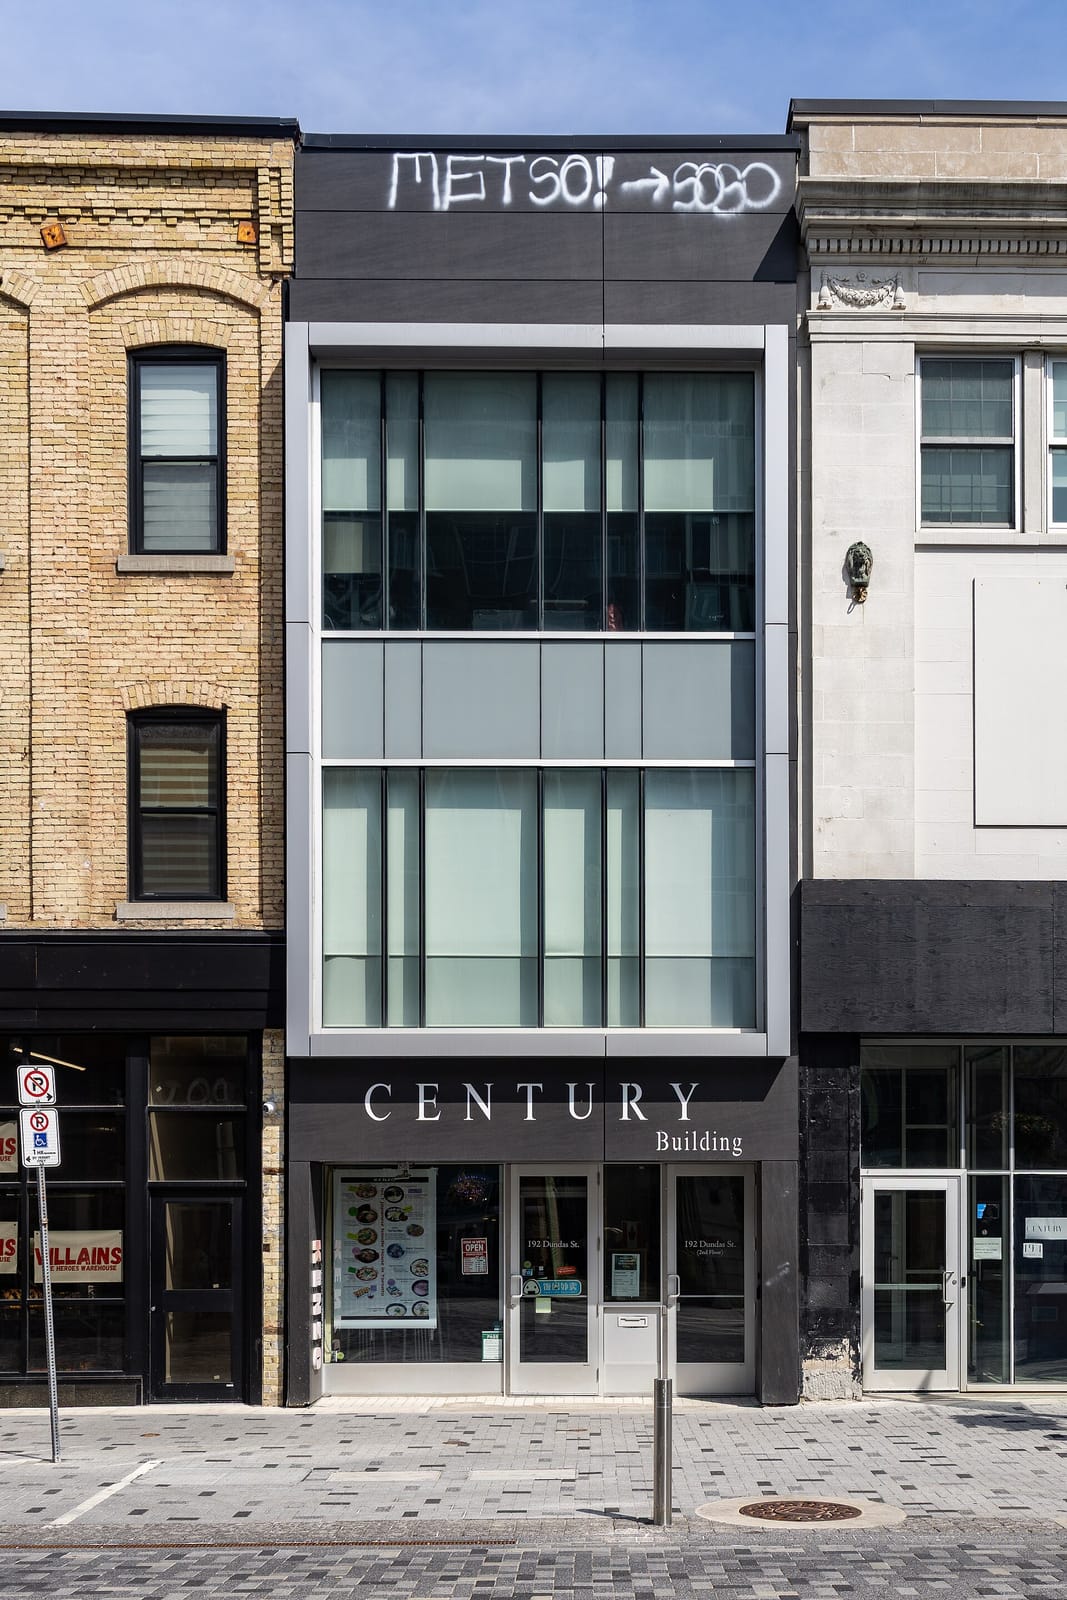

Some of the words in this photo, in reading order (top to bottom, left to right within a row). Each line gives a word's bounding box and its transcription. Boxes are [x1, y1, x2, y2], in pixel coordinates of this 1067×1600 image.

[364, 1083, 699, 1122] CENTURY
[656, 1130, 743, 1157] Building
[465, 1243, 484, 1252] OPEN
[528, 1240, 541, 1248] 192
[543, 1240, 568, 1248] Dundas
[570, 1240, 580, 1248] St.
[684, 1240, 698, 1248] 192
[699, 1240, 726, 1248] Dundas
[727, 1240, 737, 1248] St.
